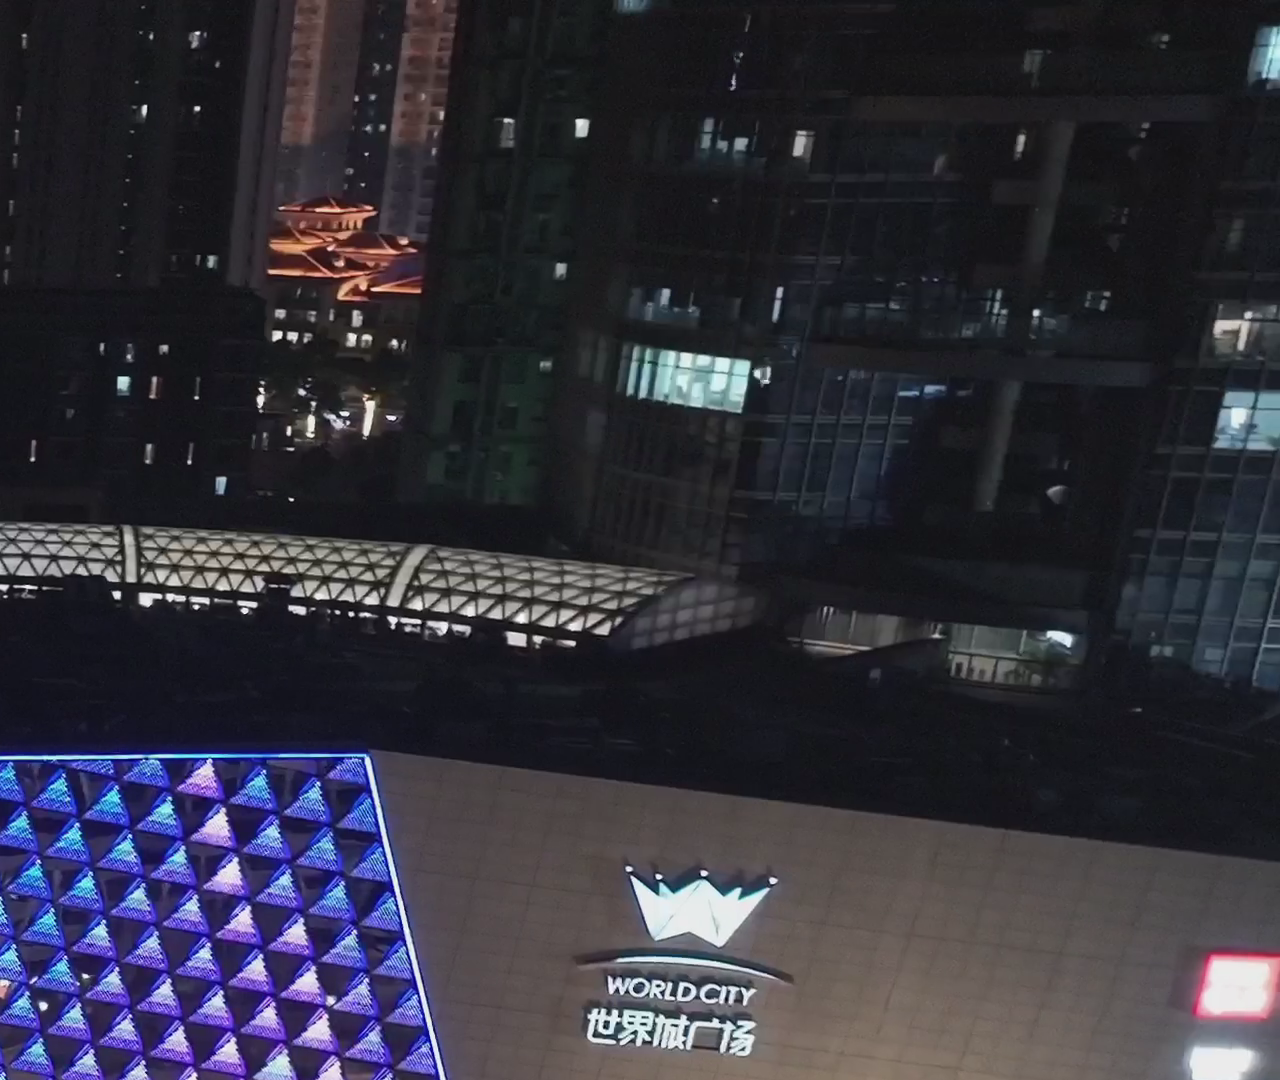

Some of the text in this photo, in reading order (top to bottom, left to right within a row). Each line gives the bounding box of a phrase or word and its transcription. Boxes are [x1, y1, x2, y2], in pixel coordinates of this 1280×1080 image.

[606, 975, 758, 1007] WORLD CITY
[586, 1007, 758, 1057] 世界城广场
